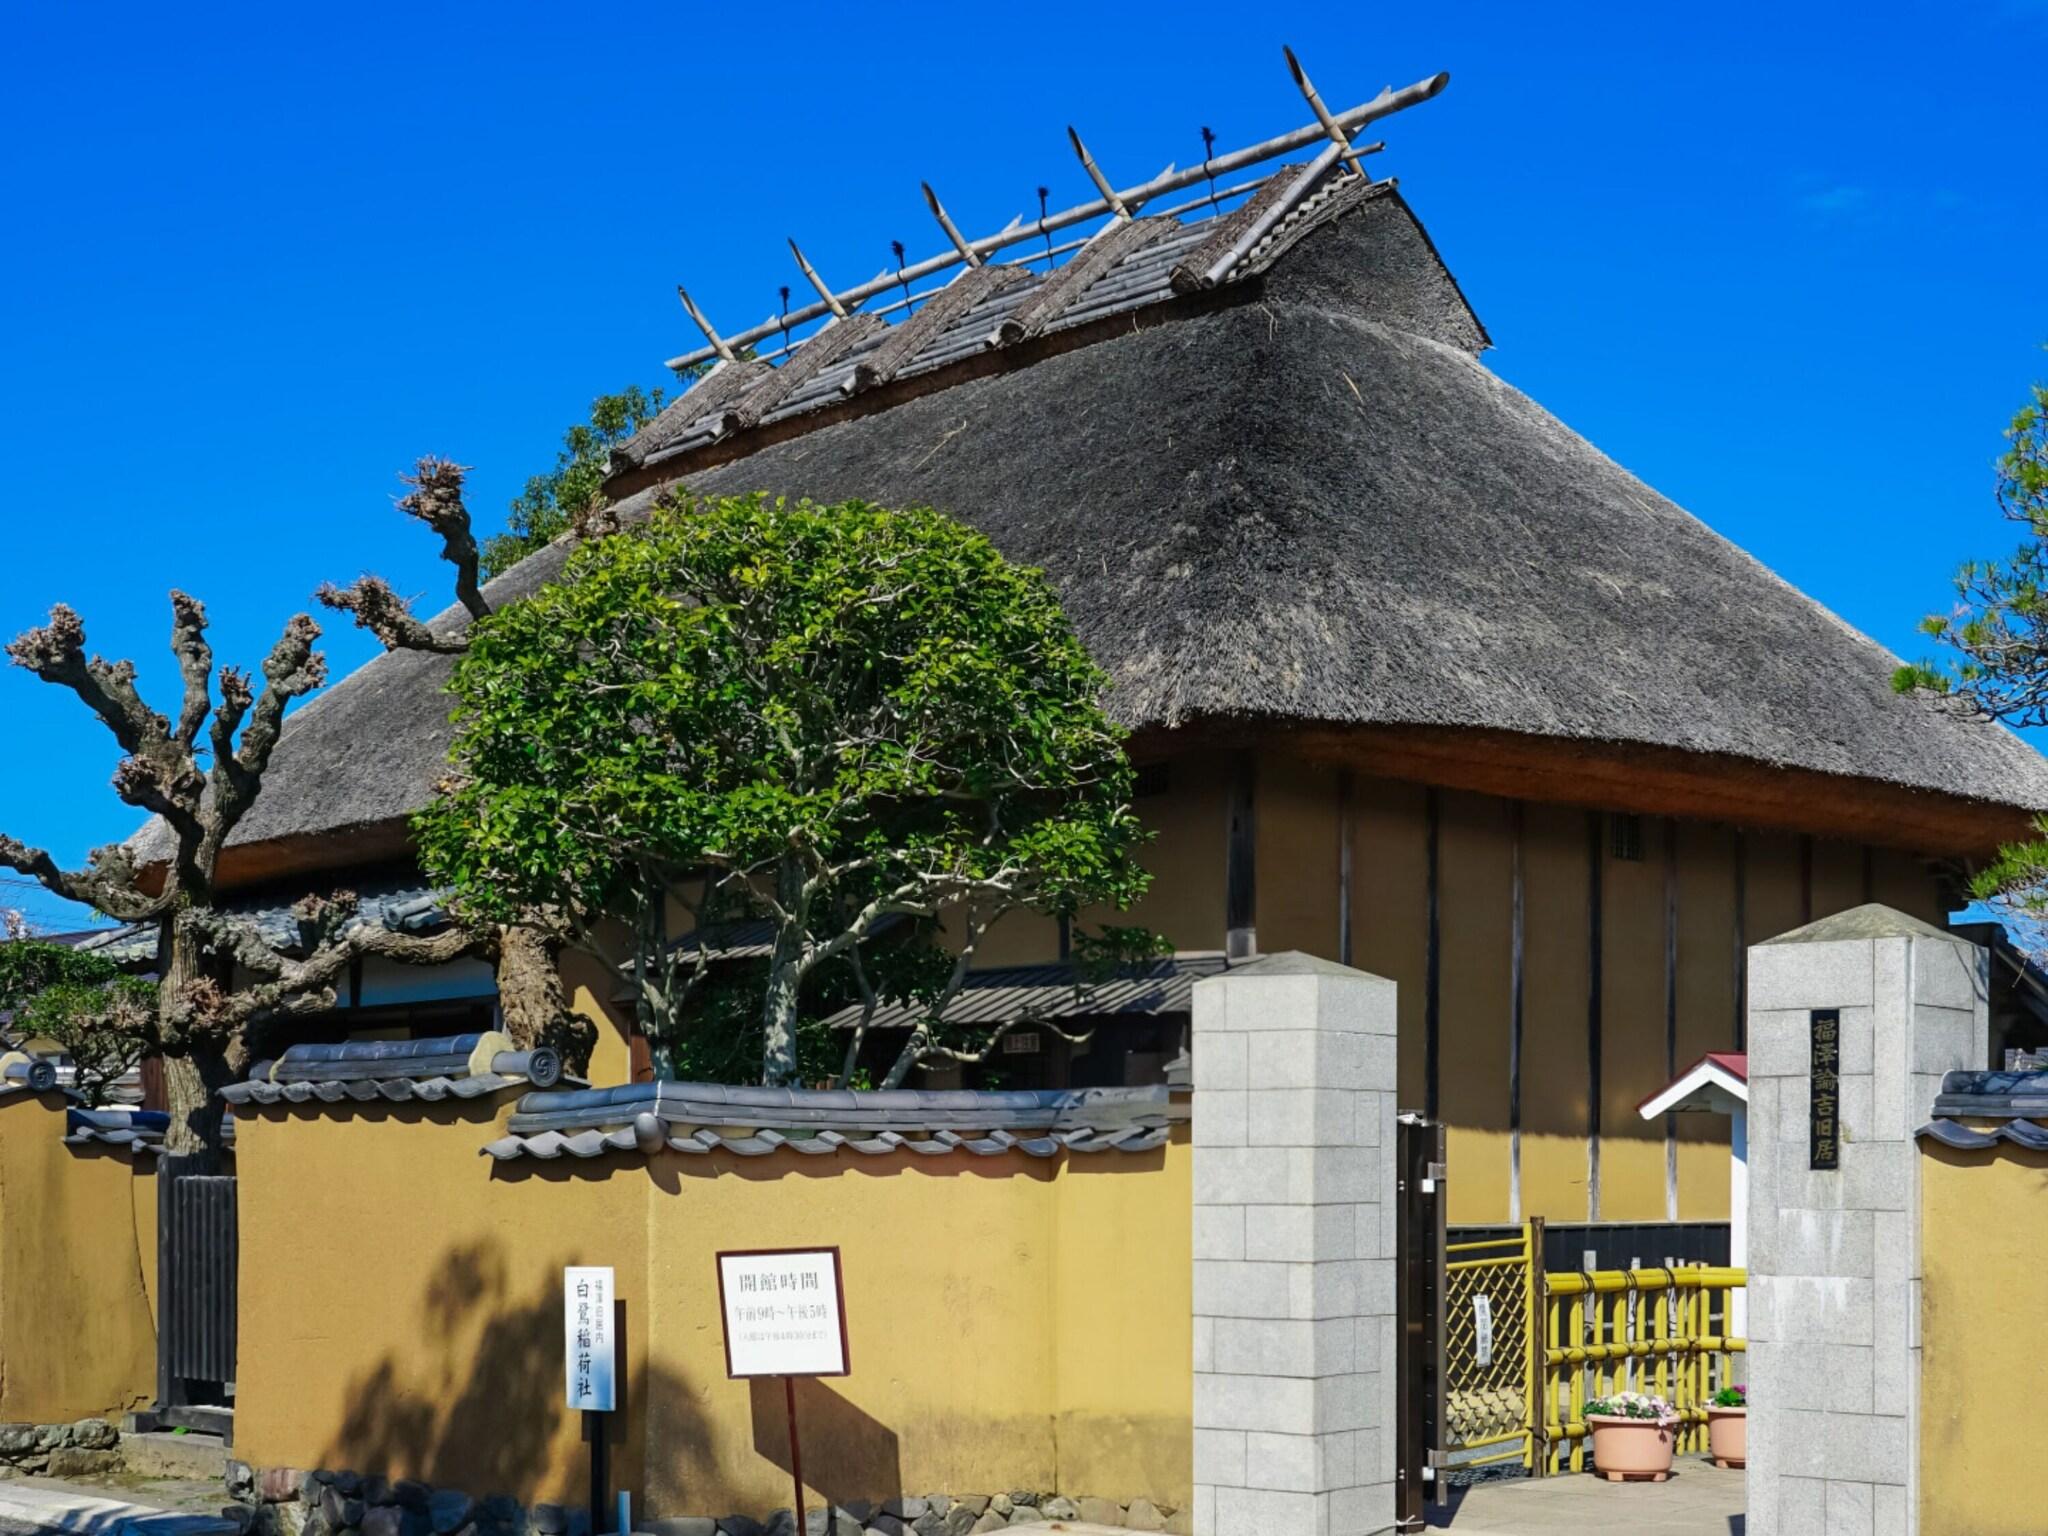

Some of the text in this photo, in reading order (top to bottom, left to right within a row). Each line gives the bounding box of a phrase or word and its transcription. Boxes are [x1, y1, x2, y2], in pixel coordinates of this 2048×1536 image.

[1812, 1019, 1839, 1161] 福澤諭吉旧居
[739, 1271, 819, 1293] 開館時間
